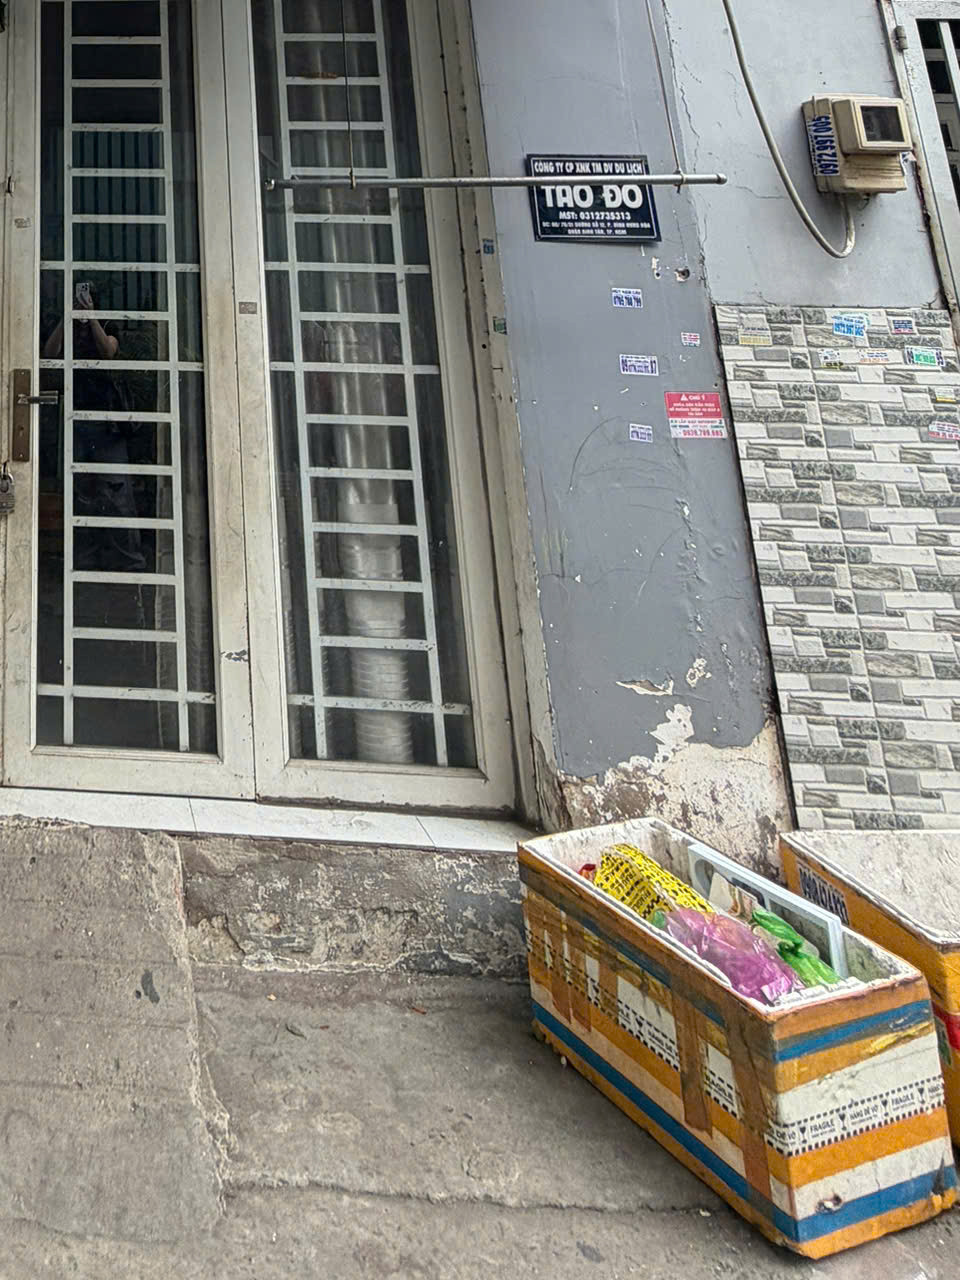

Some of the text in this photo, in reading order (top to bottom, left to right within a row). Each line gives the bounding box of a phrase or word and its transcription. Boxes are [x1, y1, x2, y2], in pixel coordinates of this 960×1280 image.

[556, 162, 565, 173] TY
[565, 162, 575, 173] CP
[604, 162, 614, 173] DV
[559, 211, 578, 220] MST:
[809, 1118, 836, 1134] FRAGILE
